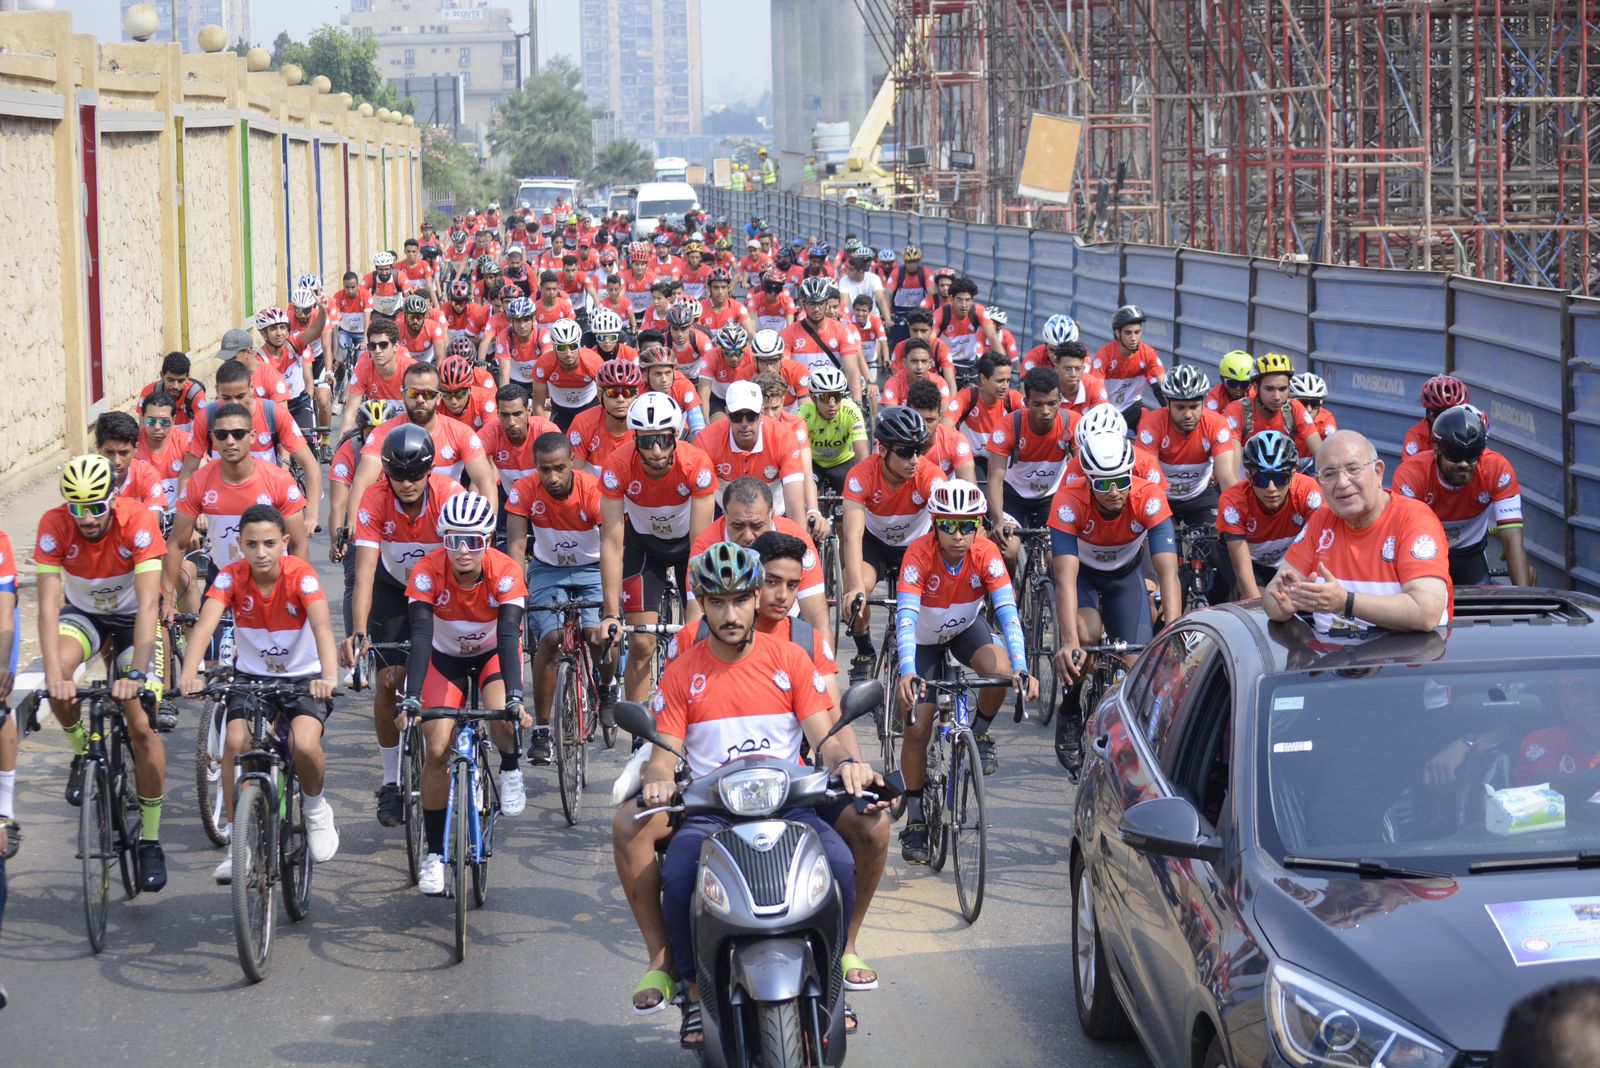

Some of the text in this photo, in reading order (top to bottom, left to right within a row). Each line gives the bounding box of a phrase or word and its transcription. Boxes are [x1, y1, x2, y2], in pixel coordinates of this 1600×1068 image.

[1025, 469, 1055, 479] مصر
[1167, 471, 1199, 480] مصر
[649, 514, 676, 522] مصر
[881, 523, 911, 533] مصر
[551, 540, 578, 552] مصر
[394, 549, 425, 564] صر
[88, 584, 124, 596] مصر
[934, 617, 966, 634] مصر
[456, 631, 487, 642] مصر
[259, 646, 289, 658] مصر
[154, 640, 165, 677] DUKLA
[720, 737, 771, 765] مصر
